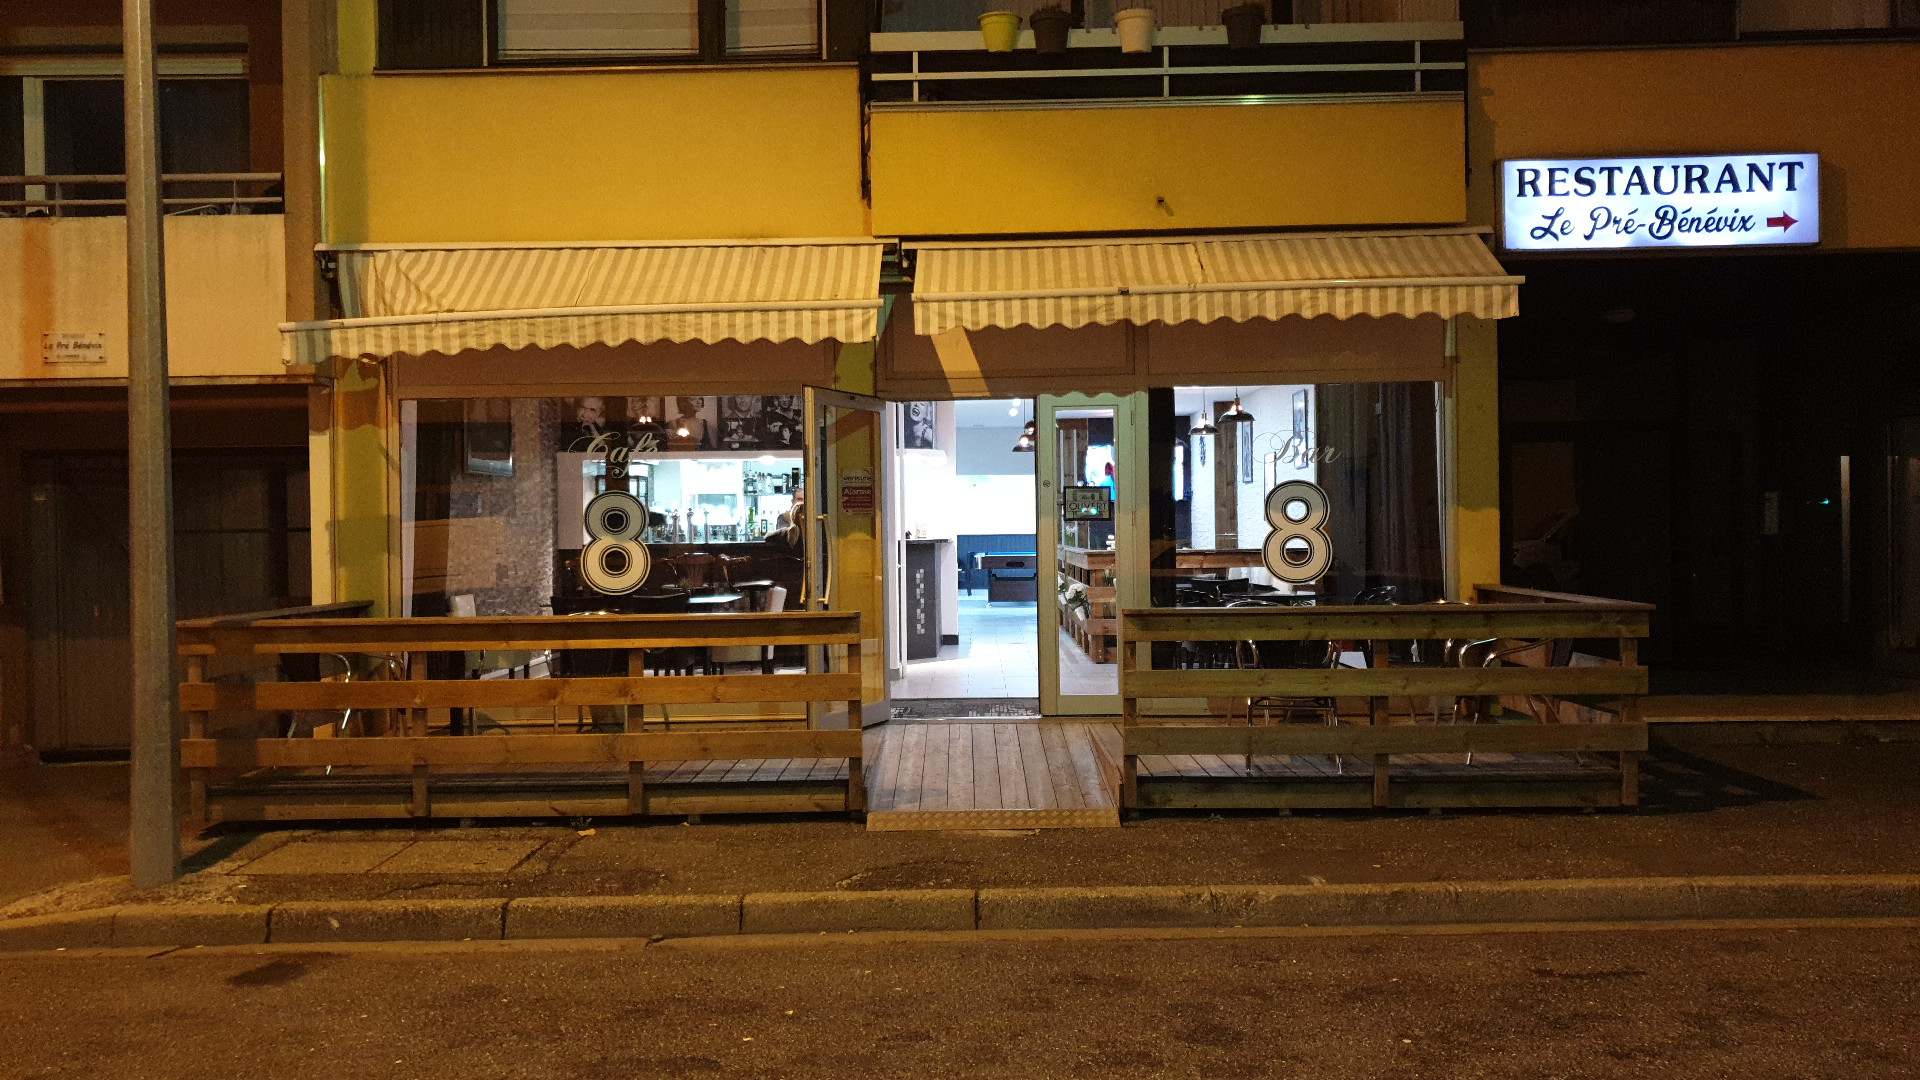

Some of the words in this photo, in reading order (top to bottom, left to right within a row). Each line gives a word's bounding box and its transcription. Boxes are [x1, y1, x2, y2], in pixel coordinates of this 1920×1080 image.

[1516, 161, 1804, 198] RESTAURANT
[1530, 206, 1575, 241] Le
[1583, 204, 1756, 241] Pré-Bénévix
[43, 341, 53, 349] Le
[568, 431, 660, 478] Café
[1253, 430, 1342, 463] Bar
[581, 490, 651, 596] 8
[1261, 479, 1333, 586] 8
